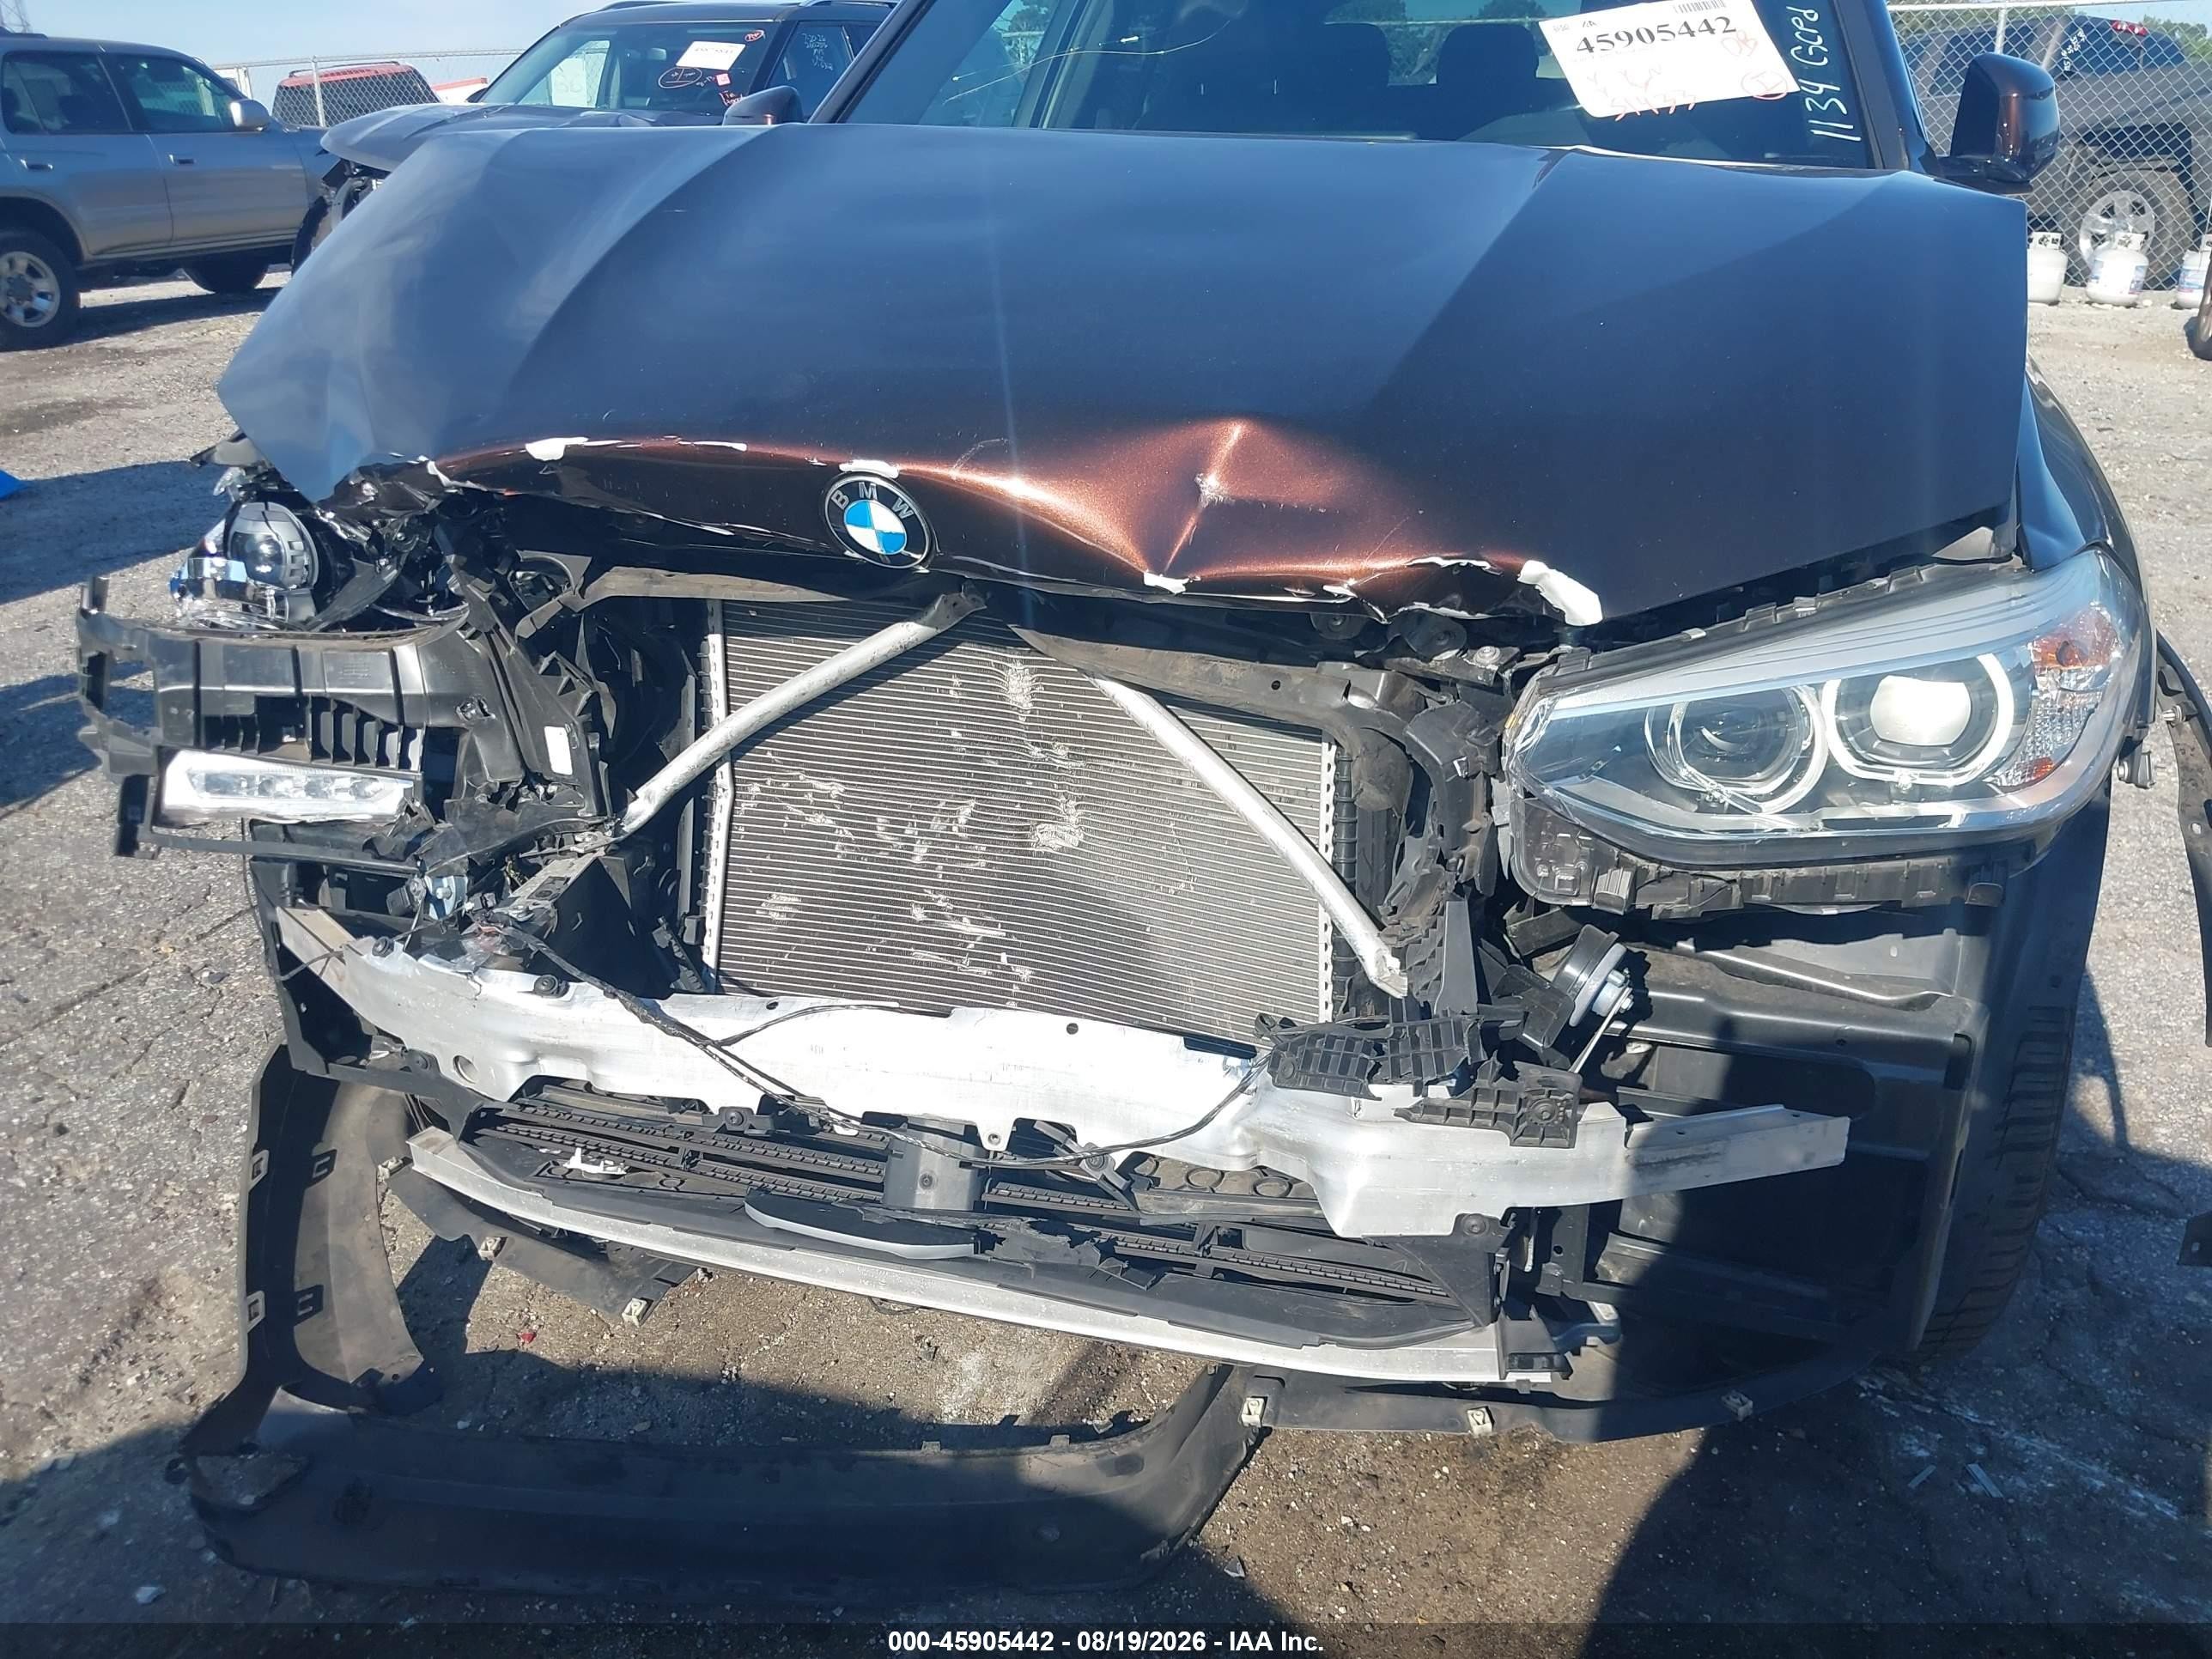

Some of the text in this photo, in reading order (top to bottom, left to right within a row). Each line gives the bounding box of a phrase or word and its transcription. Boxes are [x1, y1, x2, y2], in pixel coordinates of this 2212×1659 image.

[1576, 15, 1737, 54] 45905442
[1798, 77, 1862, 142] 1134
[831, 482, 914, 520] BMW
